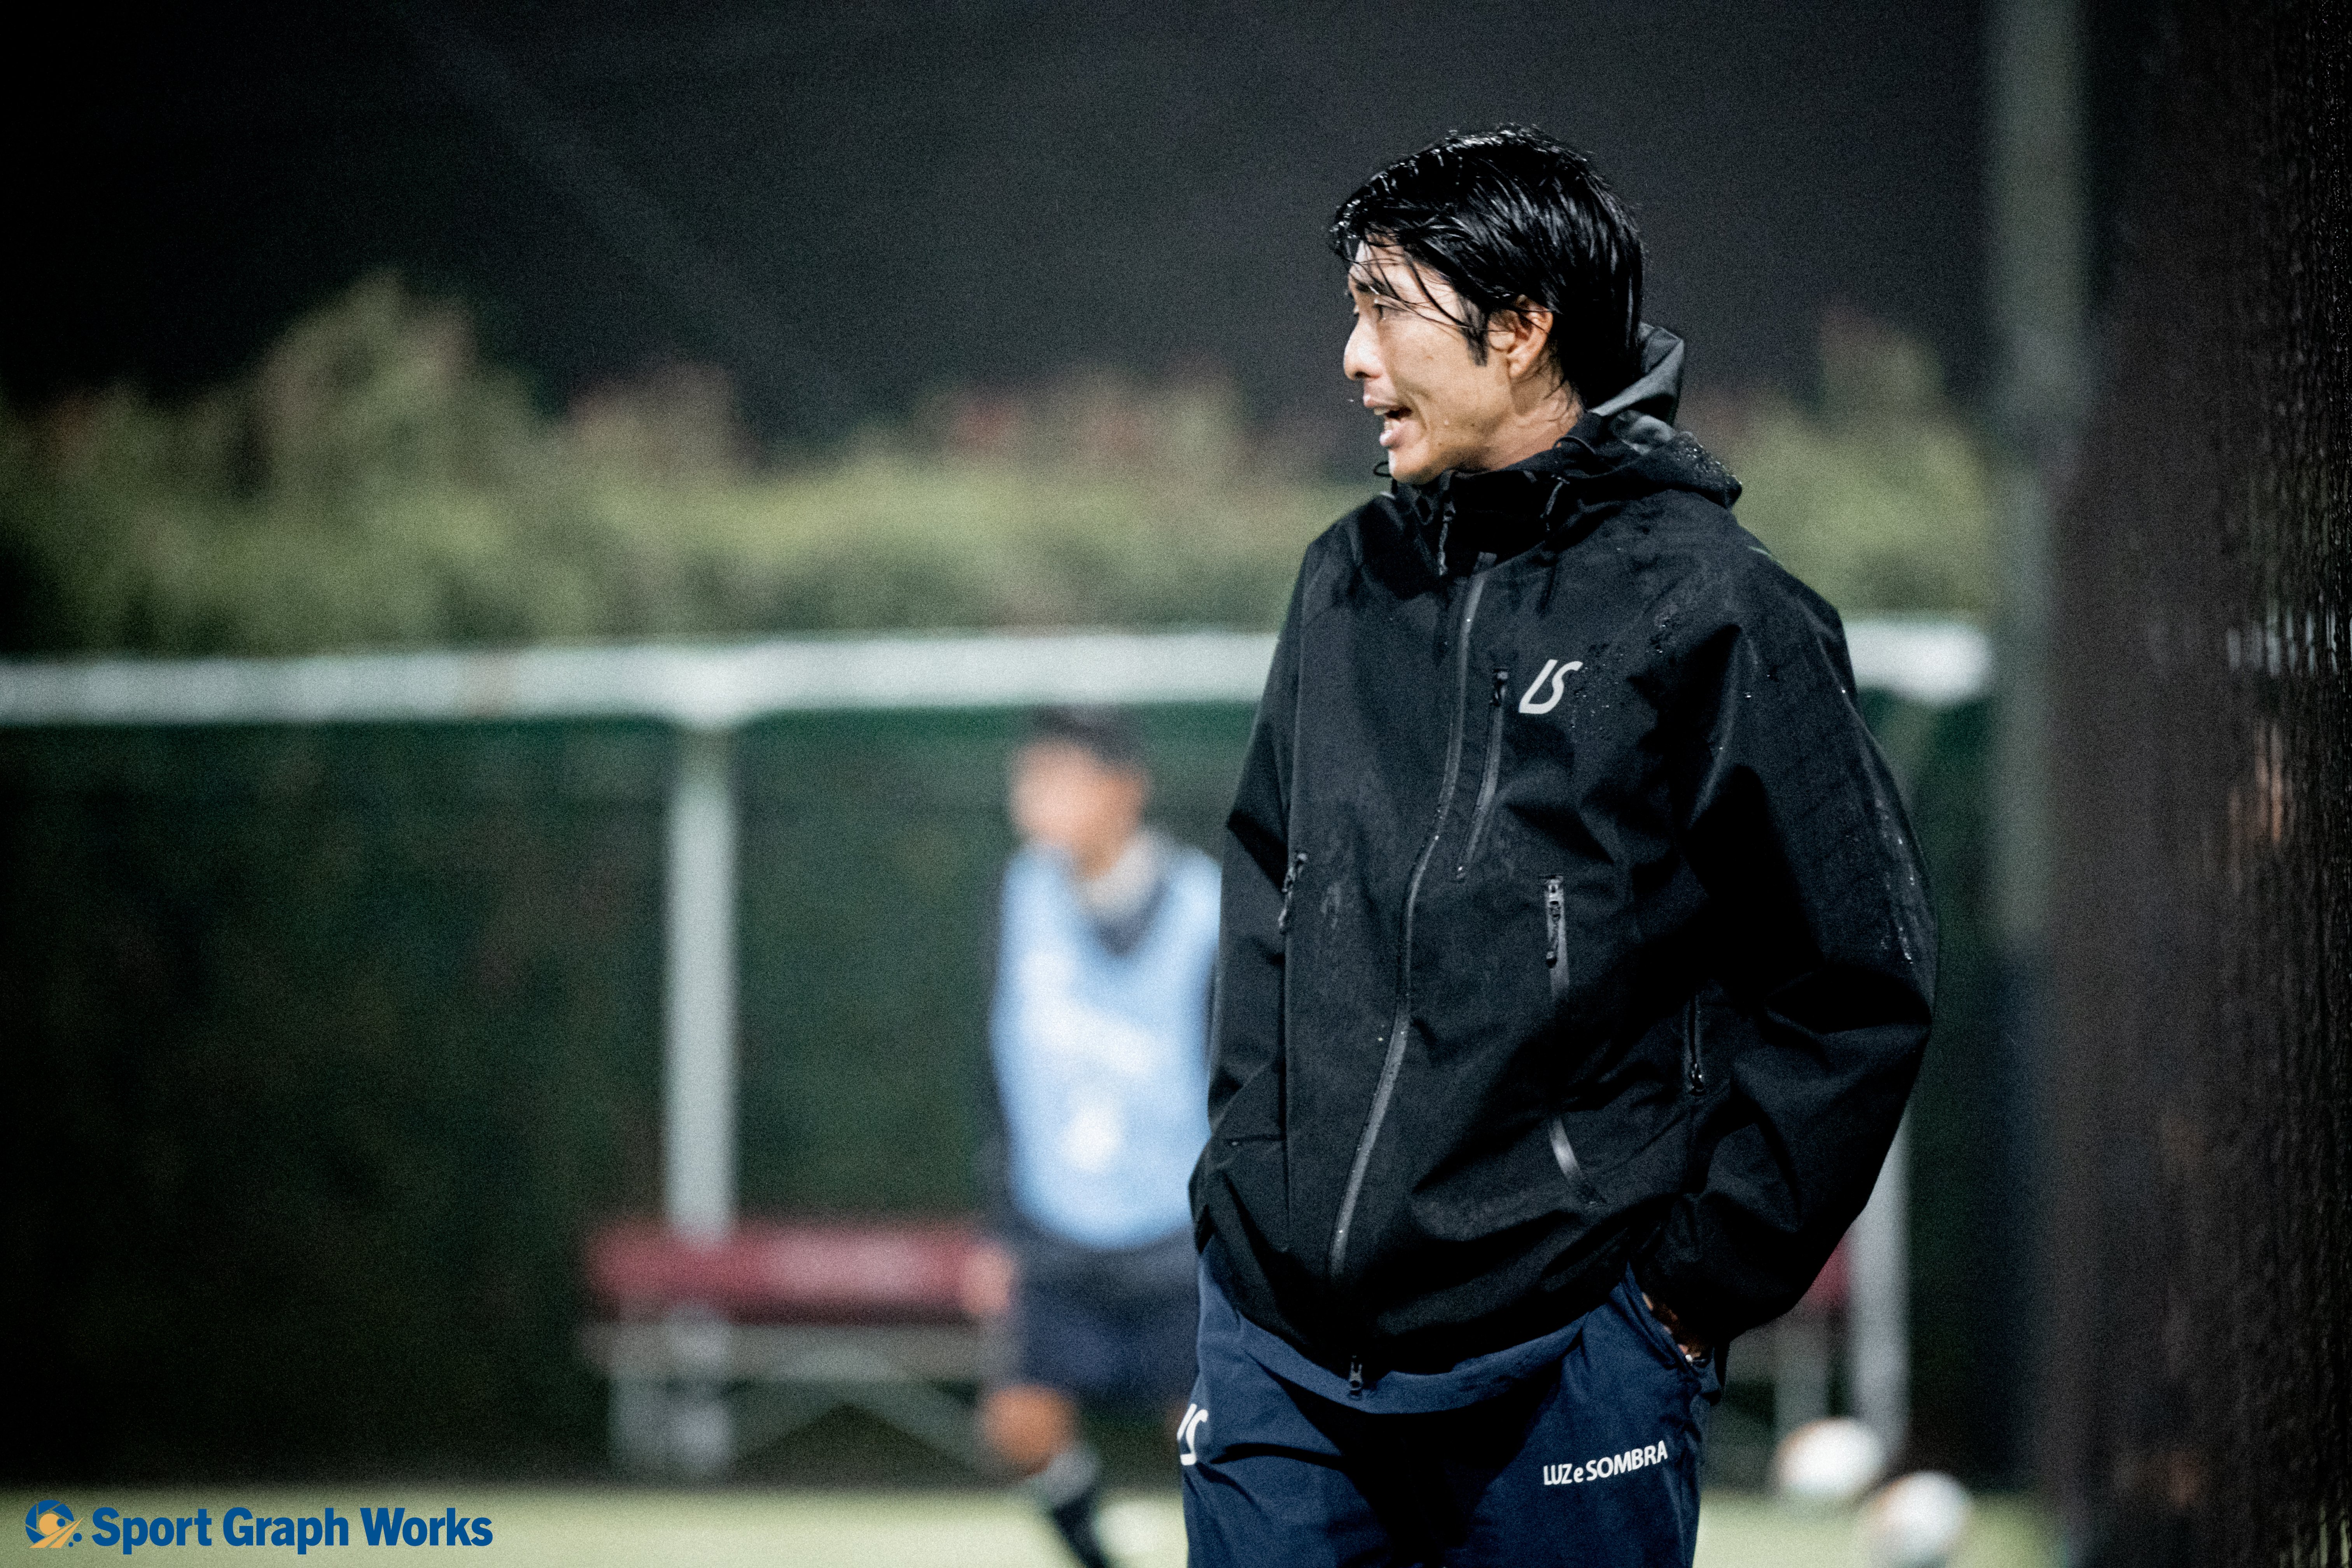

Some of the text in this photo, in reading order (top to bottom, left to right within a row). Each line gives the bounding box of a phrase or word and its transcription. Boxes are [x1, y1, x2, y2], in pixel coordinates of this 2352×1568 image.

[1543, 1440, 1668, 1485] LUZ e SOMBRA
